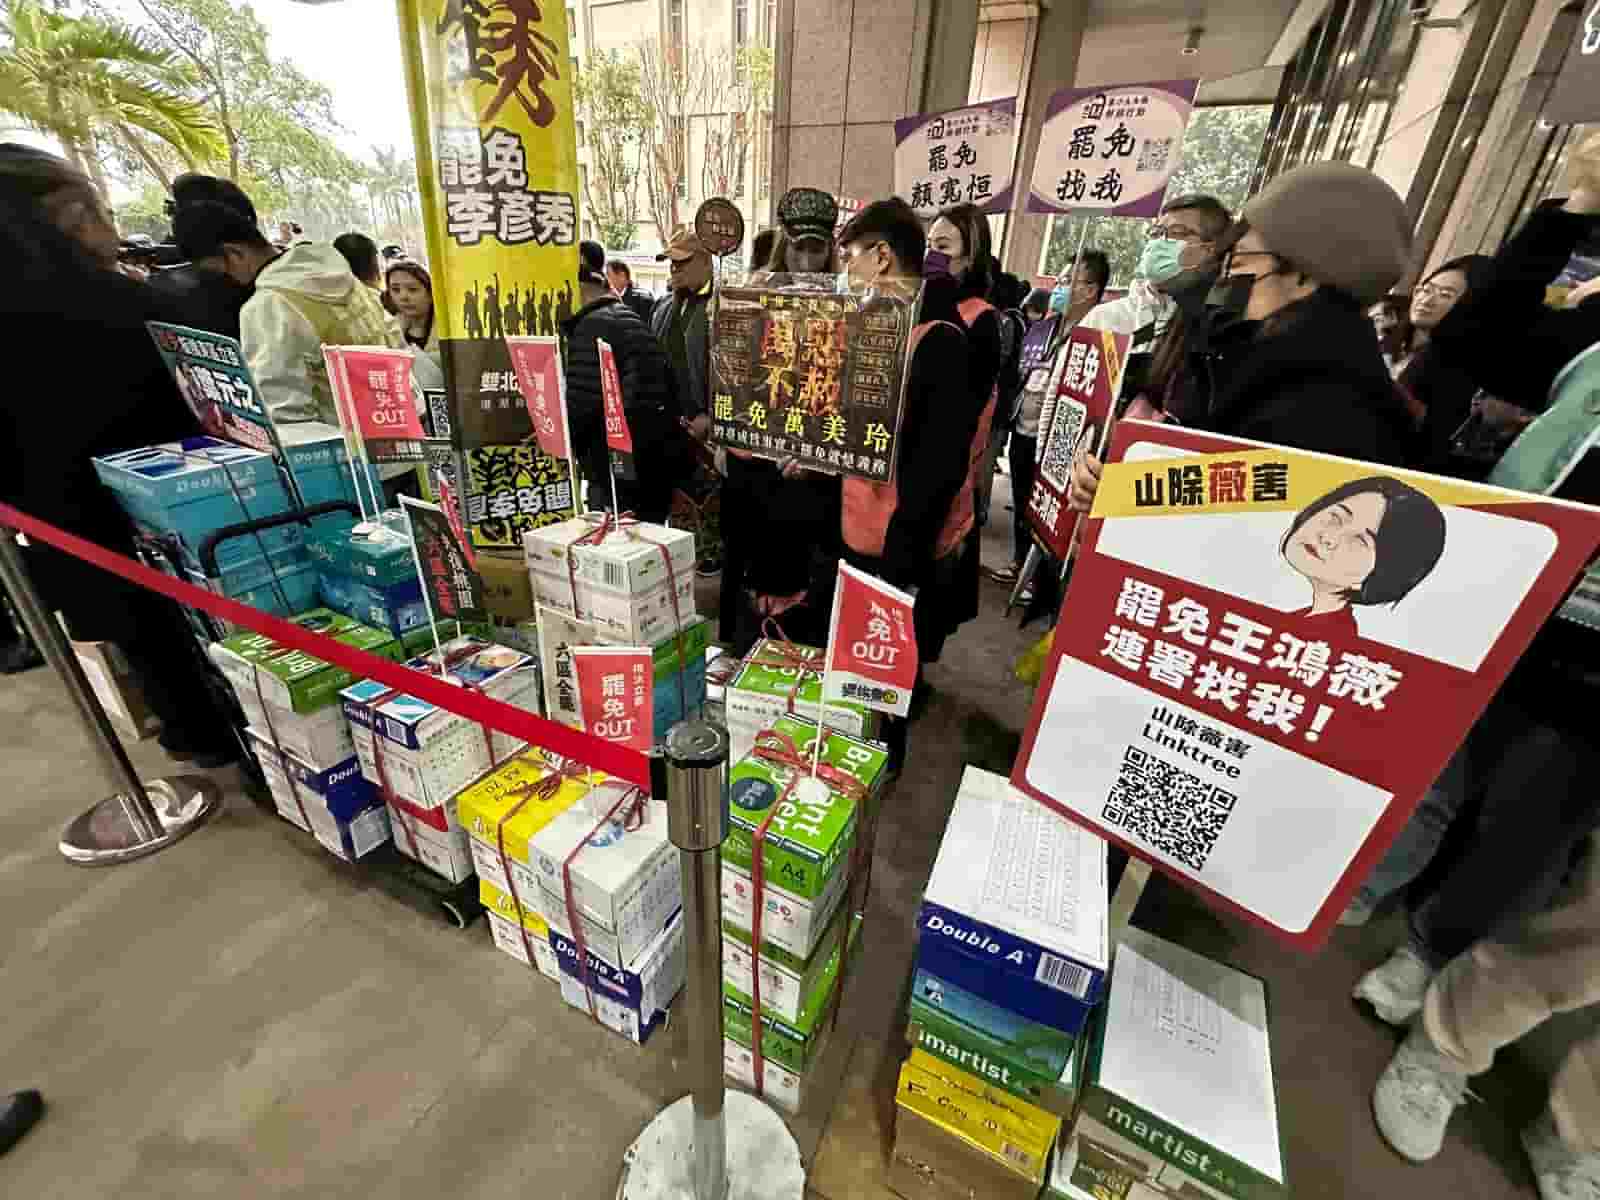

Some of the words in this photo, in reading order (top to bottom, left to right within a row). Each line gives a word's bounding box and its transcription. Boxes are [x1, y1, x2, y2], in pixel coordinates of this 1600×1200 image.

[927, 140, 977, 173] 罷免
[1067, 122, 1136, 160] 罷免
[1056, 168, 1124, 203] 找我
[446, 190, 577, 247] 李彥秀
[371, 409, 408, 425] OUT
[713, 393, 891, 453] 罷免萬美玲
[1135, 461, 1288, 507] 山除薇害
[851, 641, 902, 665] OUT
[1115, 577, 1403, 711] 罷免王鴻薇
[1101, 624, 1336, 742] 連署找我!
[593, 719, 633, 737] OUT
[1142, 723, 1242, 779] Linktree
[1151, 704, 1252, 760] 山除薇害
[926, 914, 1001, 956] Double
[1005, 948, 1025, 966] A
[612, 968, 628, 985] A
